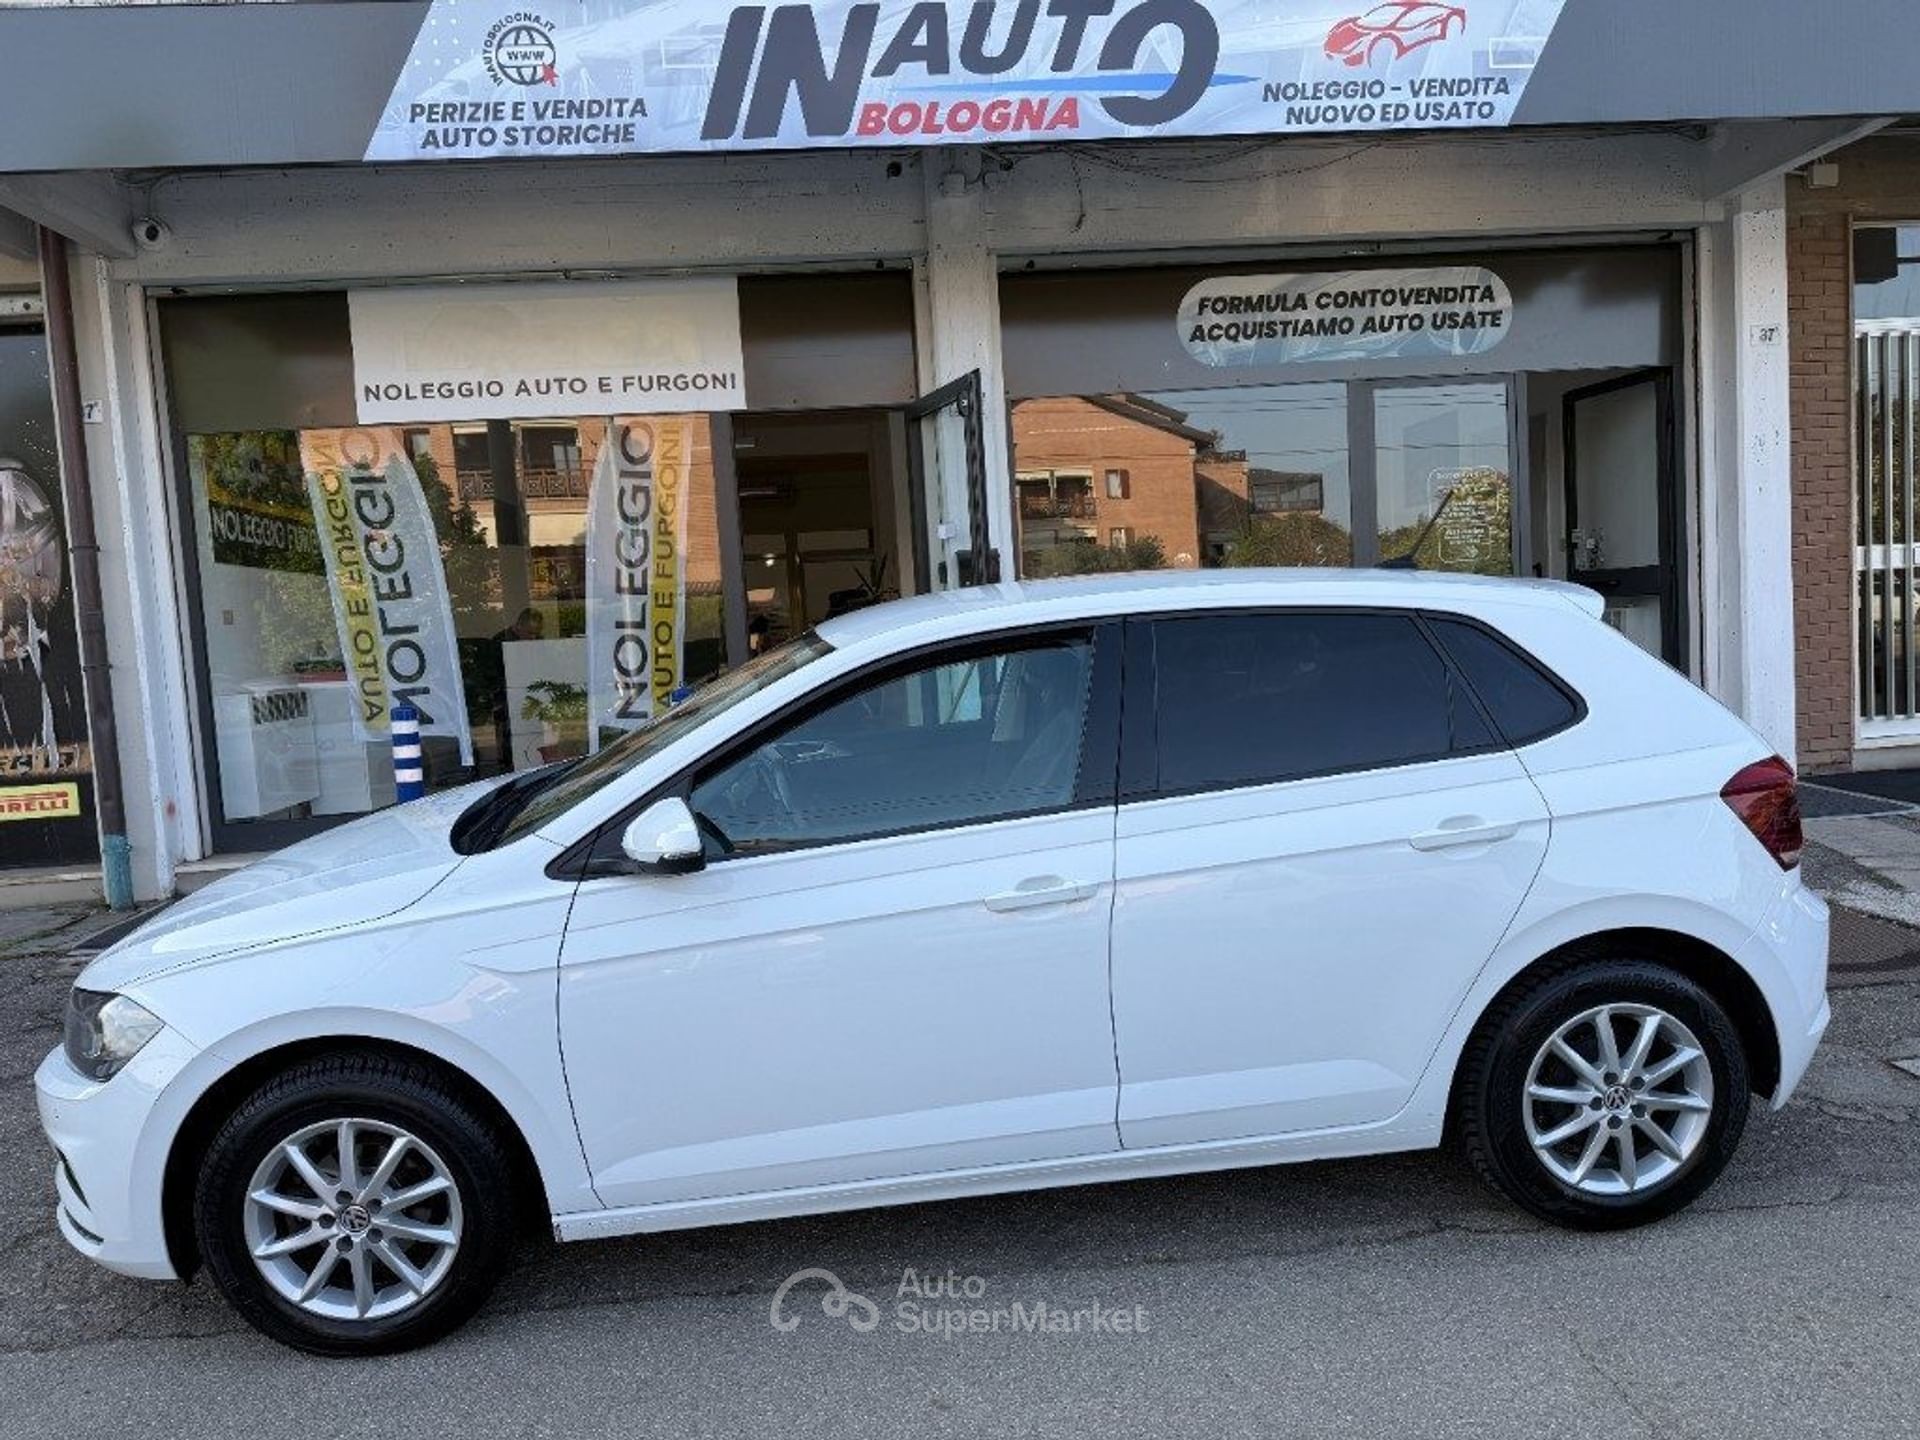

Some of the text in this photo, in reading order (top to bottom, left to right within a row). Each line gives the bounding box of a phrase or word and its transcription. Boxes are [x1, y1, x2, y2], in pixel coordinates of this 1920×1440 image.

[1263, 79, 1385, 103] NOLEGGIO
[1409, 77, 1510, 99] VENDITA
[409, 97, 648, 124] PERIZIE E VENDITA
[856, 98, 1081, 137] BOLOGNA
[1285, 100, 1495, 125] NUOVO ED USATO
[421, 123, 636, 150] AUTO STORICHE
[1197, 285, 1495, 317] FORMULA CONTOVENDITA
[1189, 309, 1503, 343] ACQUISTIAMO AUTO USATE
[364, 372, 737, 402] NOLEGGIO AUTO E FURGONI
[613, 419, 655, 720] NOLEGGIO
[655, 428, 682, 708] AUTO E FURGONI
